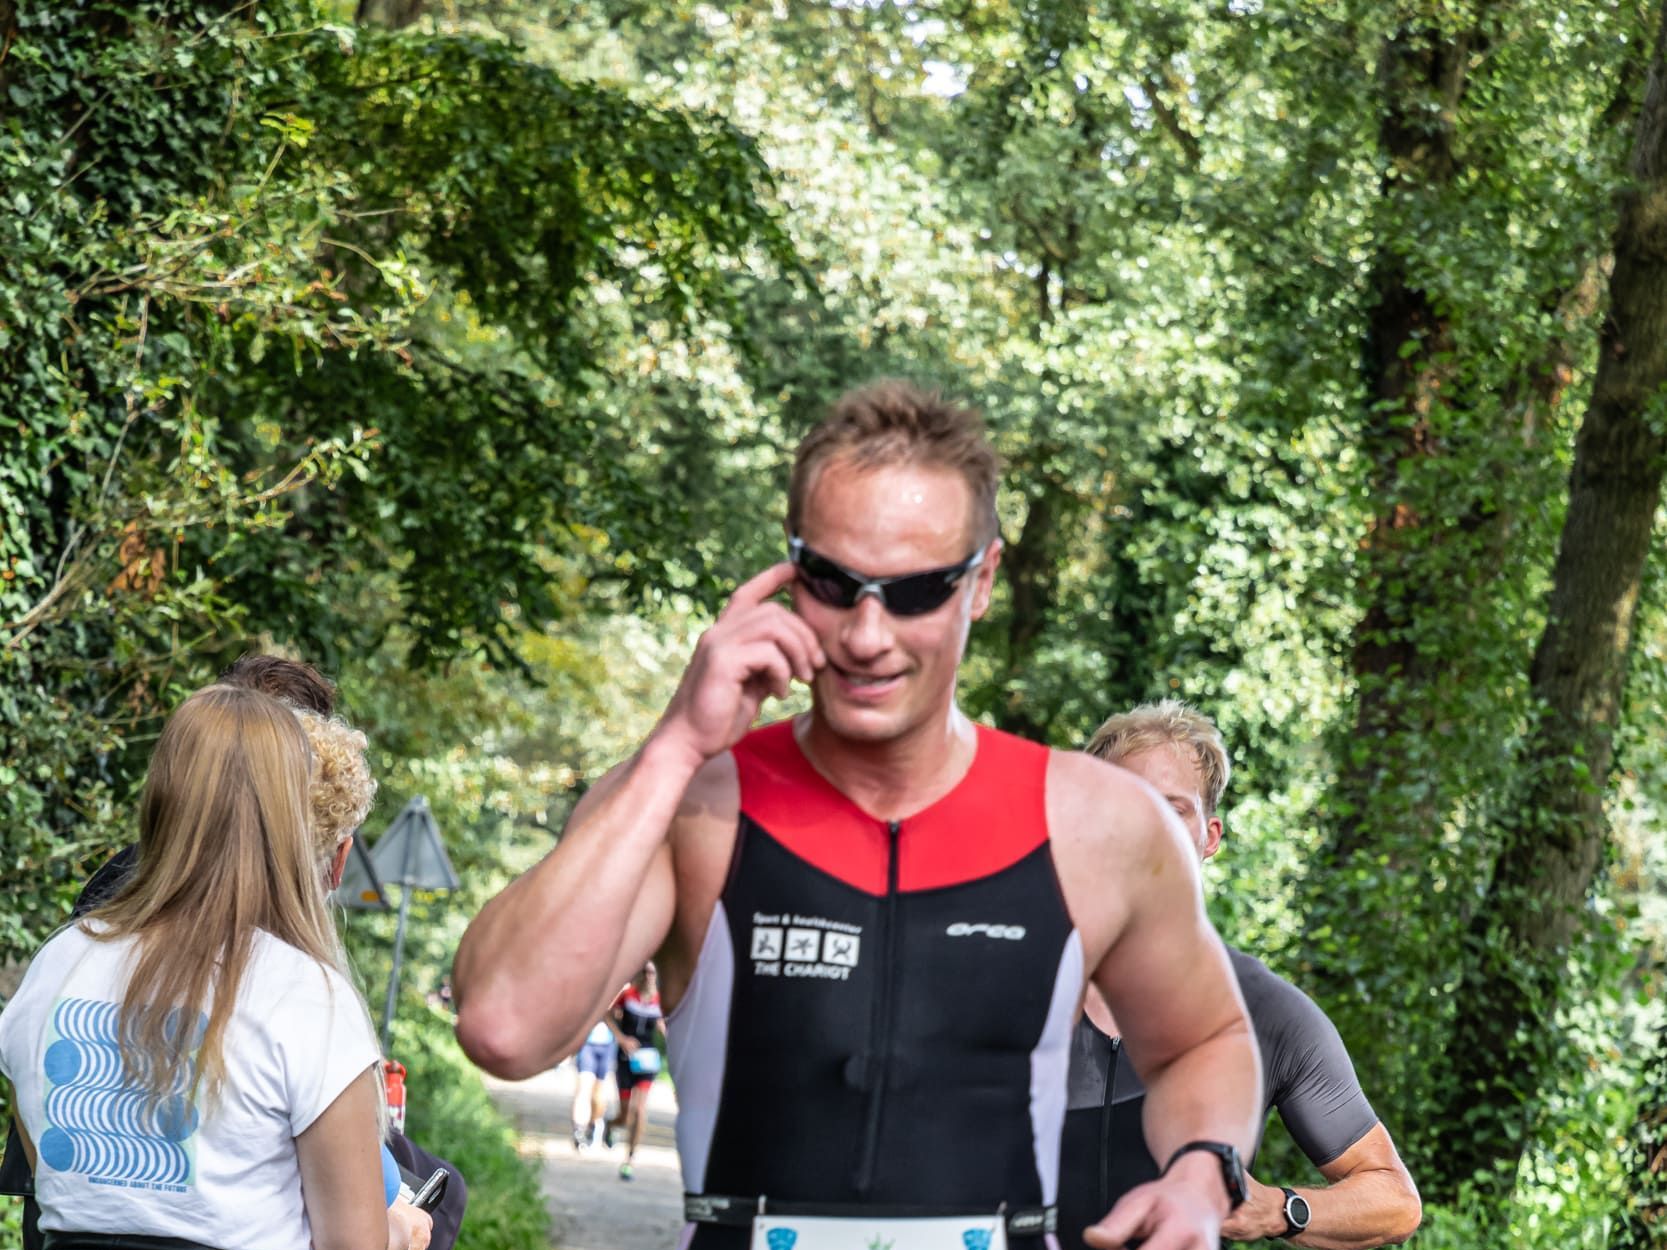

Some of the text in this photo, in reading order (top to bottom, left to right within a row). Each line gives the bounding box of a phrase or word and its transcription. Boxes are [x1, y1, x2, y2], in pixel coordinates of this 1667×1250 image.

[754, 961, 851, 981] THE CHARIOT
[129, 1180, 149, 1189] ABOUT
[151, 1182, 162, 1191] THE
[164, 1184, 188, 1193] FUTURE
